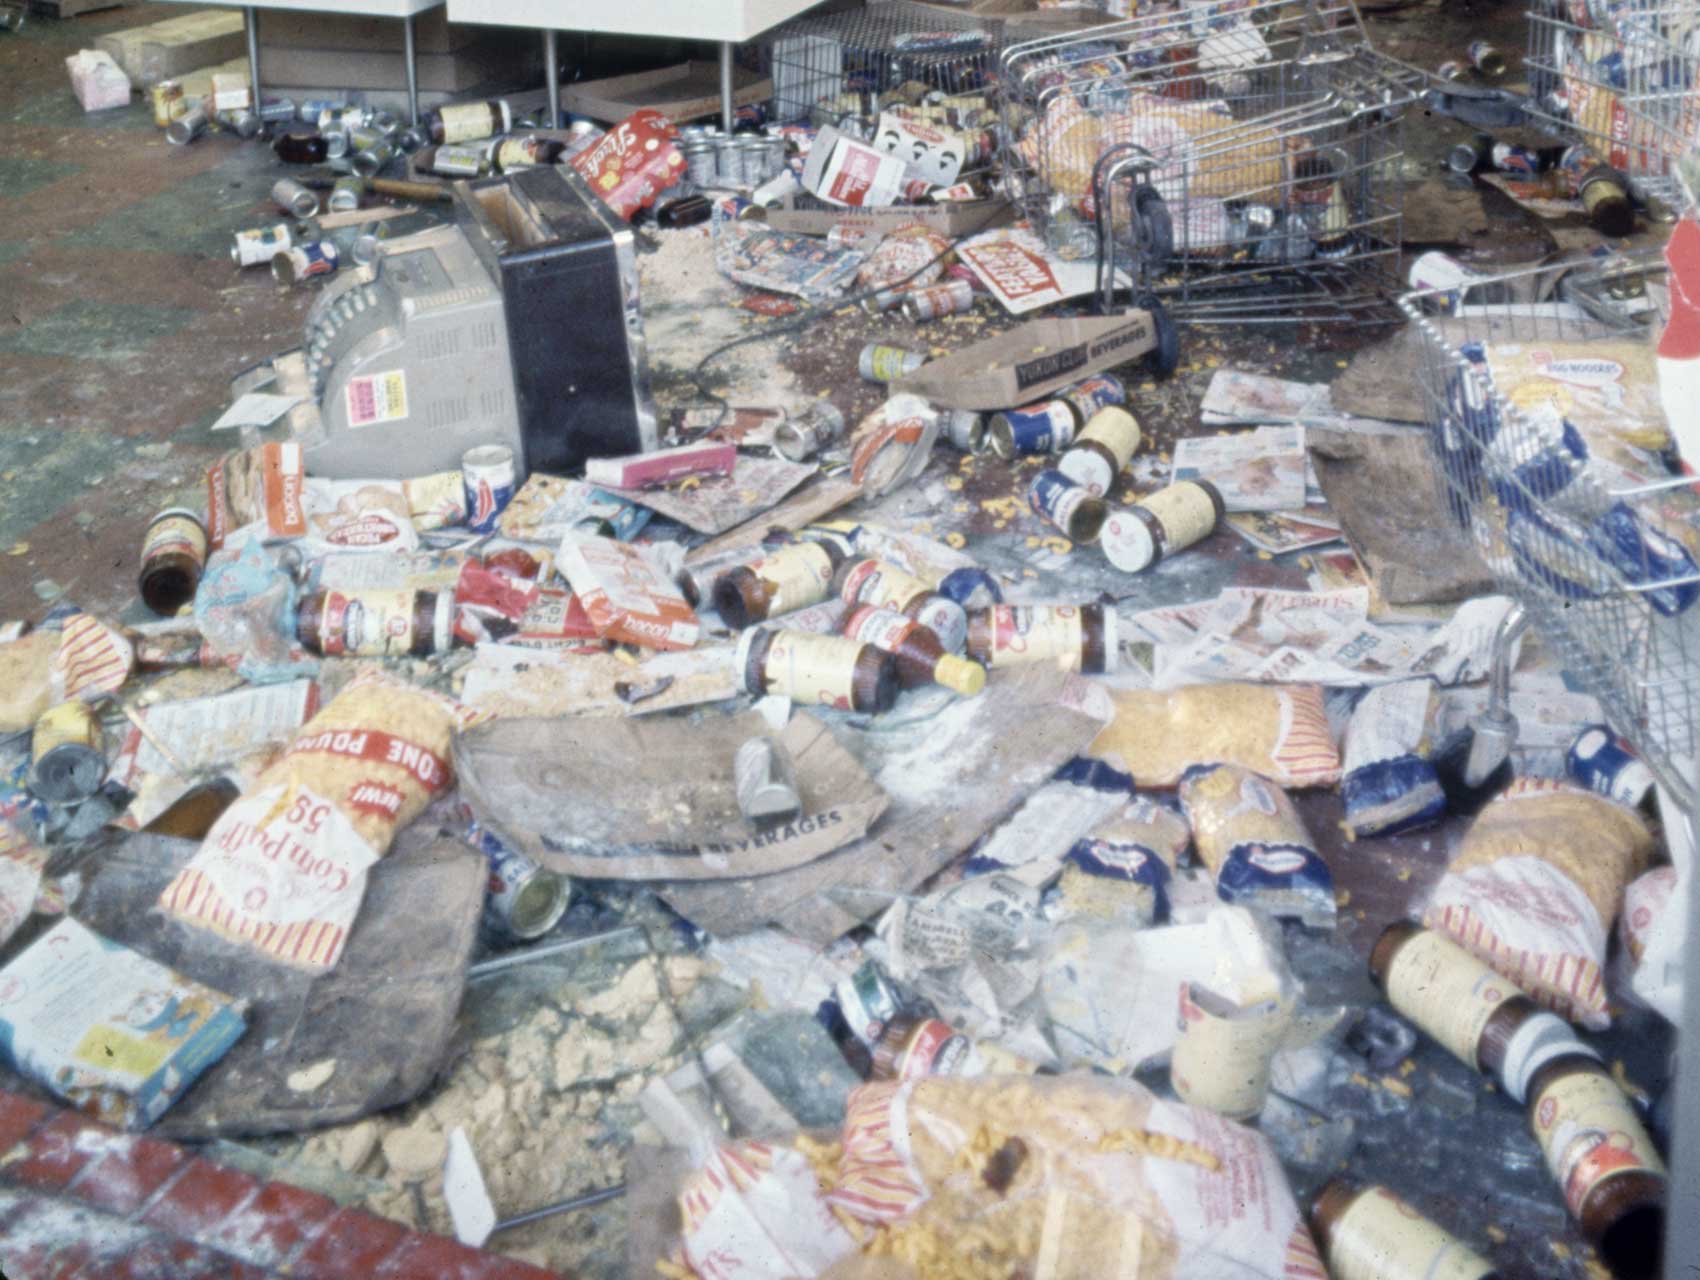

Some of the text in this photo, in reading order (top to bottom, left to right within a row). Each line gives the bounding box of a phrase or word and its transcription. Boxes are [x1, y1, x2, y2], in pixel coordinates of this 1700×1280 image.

[1018, 355, 1061, 389] YUKON
[1090, 327, 1147, 358] BEVERAGES
[622, 617, 670, 642] bacon
[390, 740, 436, 780] ONE
[708, 810, 844, 853] BEVERAGES
